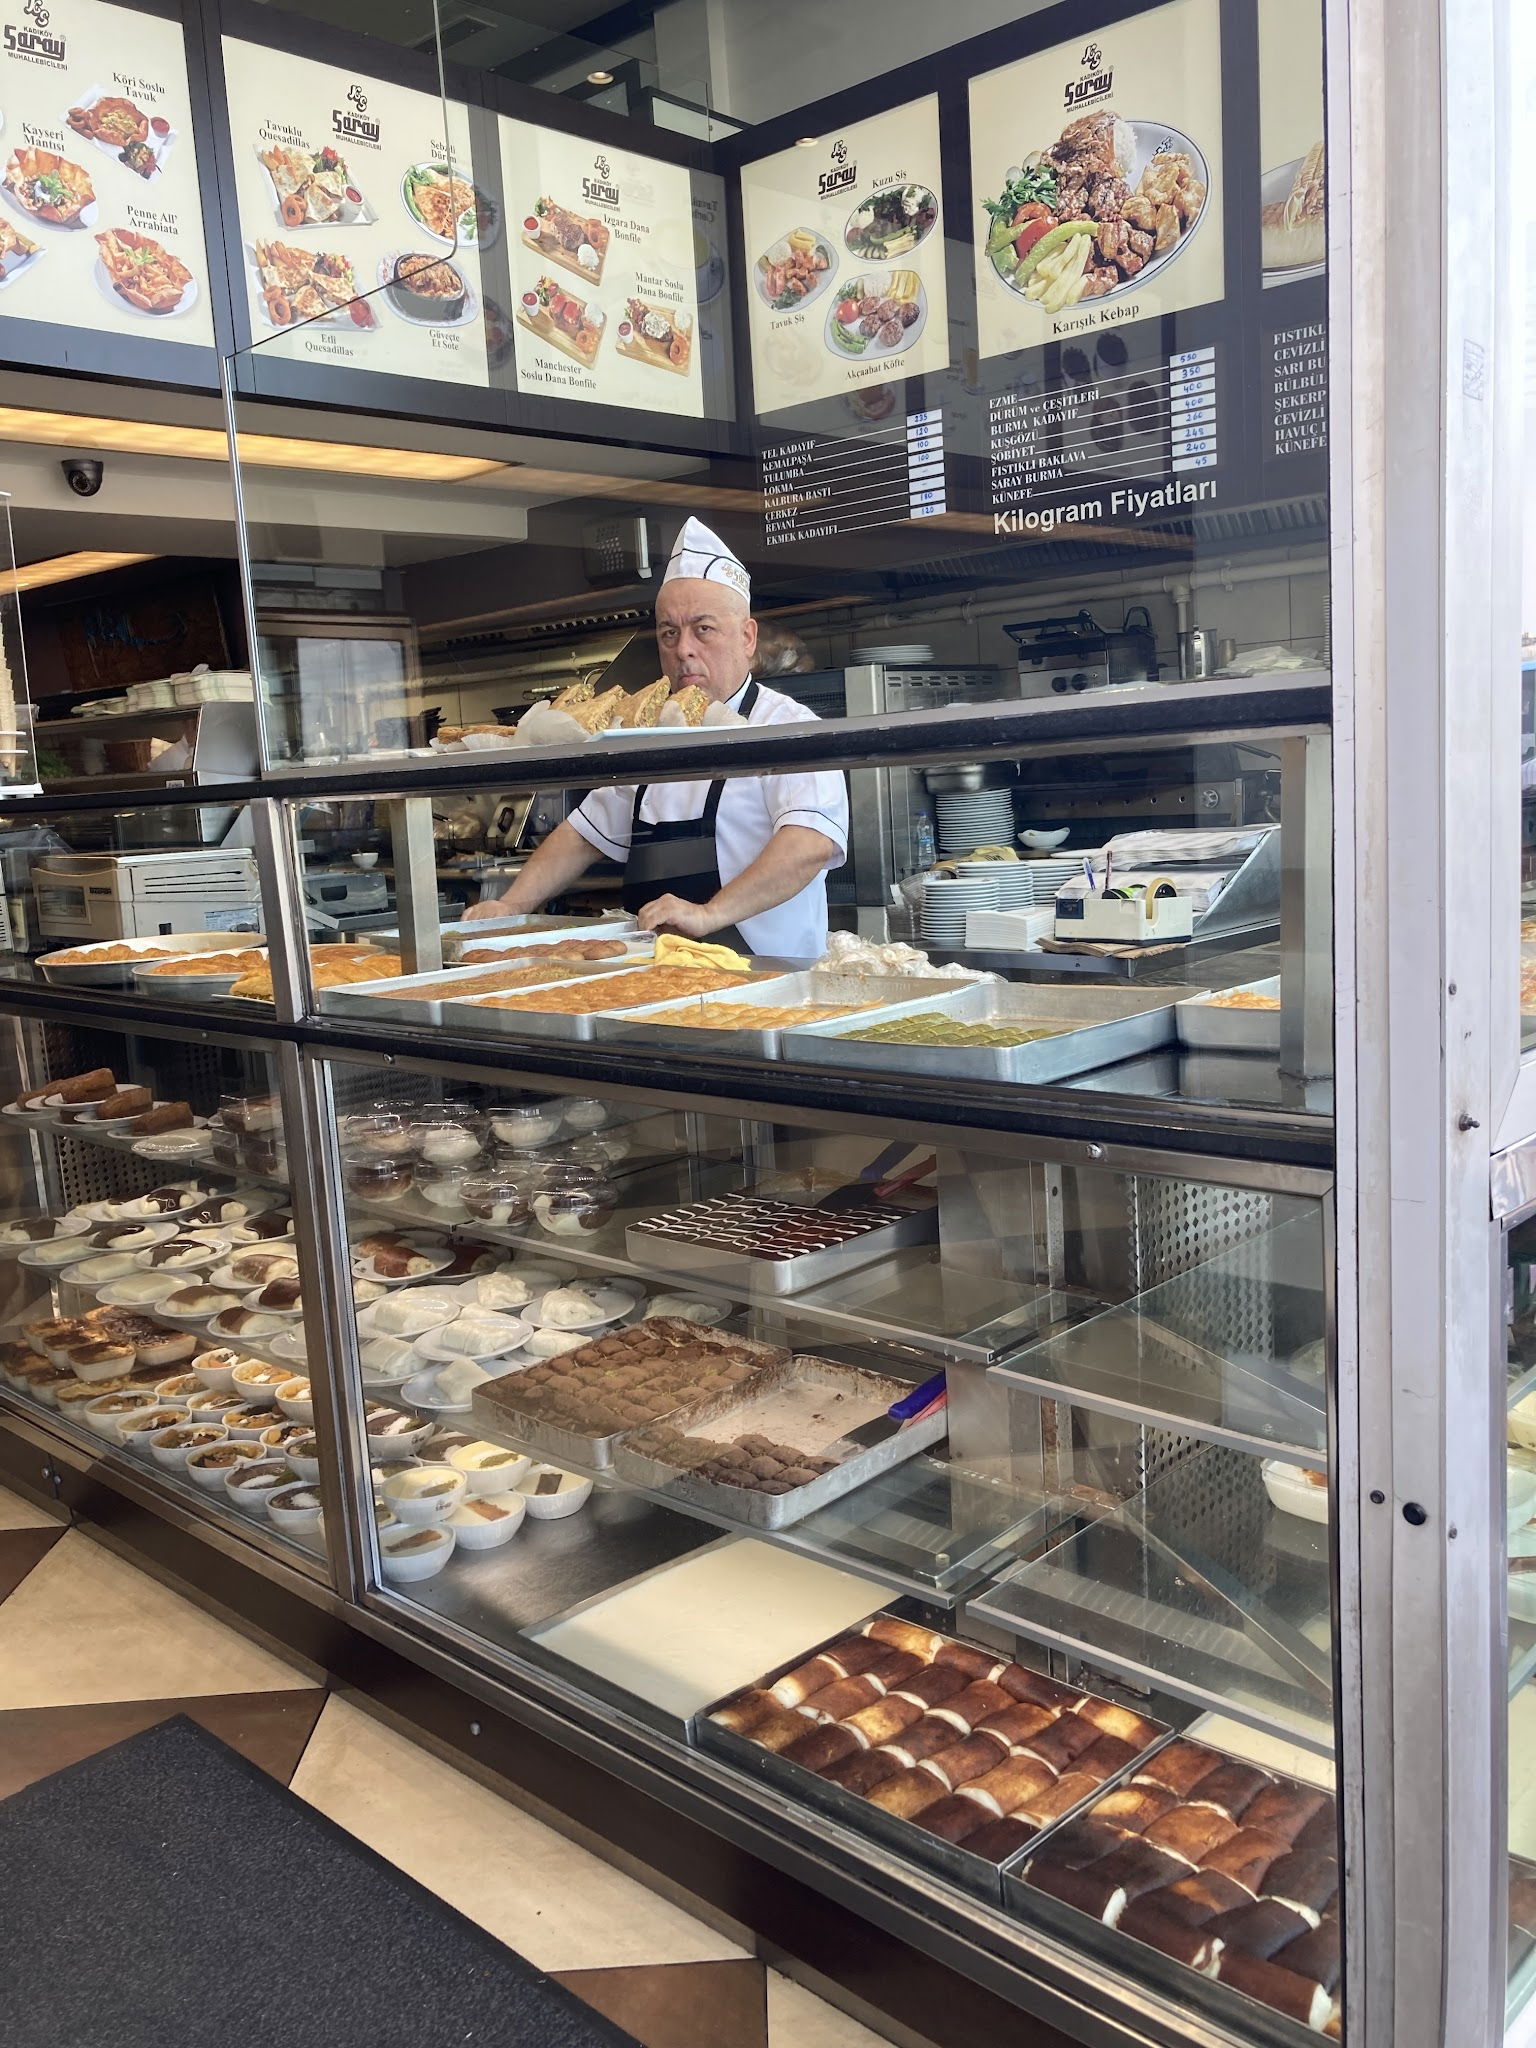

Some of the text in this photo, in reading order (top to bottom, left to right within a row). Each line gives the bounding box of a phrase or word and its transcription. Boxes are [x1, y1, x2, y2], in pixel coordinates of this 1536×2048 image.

[23, 26, 53, 38] KADIKÖY
[4, 24, 66, 62] Saray
[8, 52, 68, 71] MUHALLEBİCİLERİ
[113, 72, 165, 94] Köri Soslu
[1080, 69, 1104, 82] KADIKÖY
[124, 86, 157, 103] Tavuk
[1063, 71, 1113, 108] Saray
[347, 111, 370, 121] KADIKÖY
[22, 122, 64, 141] Kayseri
[264, 119, 302, 137] Tavuklu
[332, 109, 380, 142] Saray
[23, 134, 65, 152] Mantısı
[259, 128, 310, 149] Quesadillas
[431, 149, 457, 164] Dürm
[818, 165, 857, 195] Saray
[872, 169, 907, 189] Kuzu Şiş
[582, 177, 619, 205] Saray
[127, 205, 157, 220] Penne
[129, 217, 179, 235] Arrabiata
[604, 213, 650, 234] Izgara Dana
[615, 229, 641, 244] Bonfile
[636, 272, 684, 291] Mantar Soslu
[637, 284, 684, 303] Dana Bonfile
[770, 313, 805, 330] Tavuk Şiş
[1053, 305, 1139, 334] Karışık Kebap
[321, 333, 337, 345] Etli
[429, 329, 460, 343] Güveçte
[431, 338, 459, 351] Et Sote
[305, 341, 354, 357] Quesadillas
[1274, 338, 1325, 362] CEVİZLİ
[535, 358, 582, 374] Manchester
[845, 358, 905, 381] Akçaabat Köfte
[1182, 366, 1200, 379] 350
[1274, 361, 1303, 378] SARI
[521, 369, 597, 390] Soslu Dana Bonfile
[1183, 382, 1202, 393] 400
[1274, 373, 1327, 394] BÜLBÜL
[989, 394, 1018, 409] EZME
[990, 388, 1100, 422] DÜRÜM ve ÇEŞİTLERİ
[1185, 398, 1203, 408] 400
[991, 408, 1079, 436] BURMA KADAYIF
[1274, 404, 1325, 426] CEVİZLİ
[991, 429, 1039, 450] KUŞGÖZÜ
[1275, 423, 1318, 441] HAVUÇ
[762, 439, 816, 460] TEL KADAYIF
[917, 440, 929, 449] 100
[1186, 442, 1206, 452] 240
[1275, 435, 1327, 455] KÜNEFE
[762, 453, 813, 472] KEMALPAŞA
[918, 453, 930, 462] 100
[991, 445, 1036, 466] ŞÖBİYET
[991, 450, 1086, 477] FISTIKLI BAKLAVA
[1195, 456, 1207, 466] 45
[763, 469, 805, 484] TULUMBA
[991, 468, 1063, 491] SARAY BURMA
[763, 482, 794, 497] LOKMA
[764, 487, 832, 509] KALBURA BASTI
[992, 488, 1033, 505] KÜNEFE
[765, 507, 798, 523] ÇERKEZ
[993, 480, 1217, 535] Kilogram Fiyatları
[765, 518, 796, 534] REVANİ
[766, 524, 838, 546] EKMEK KADAYIFI
